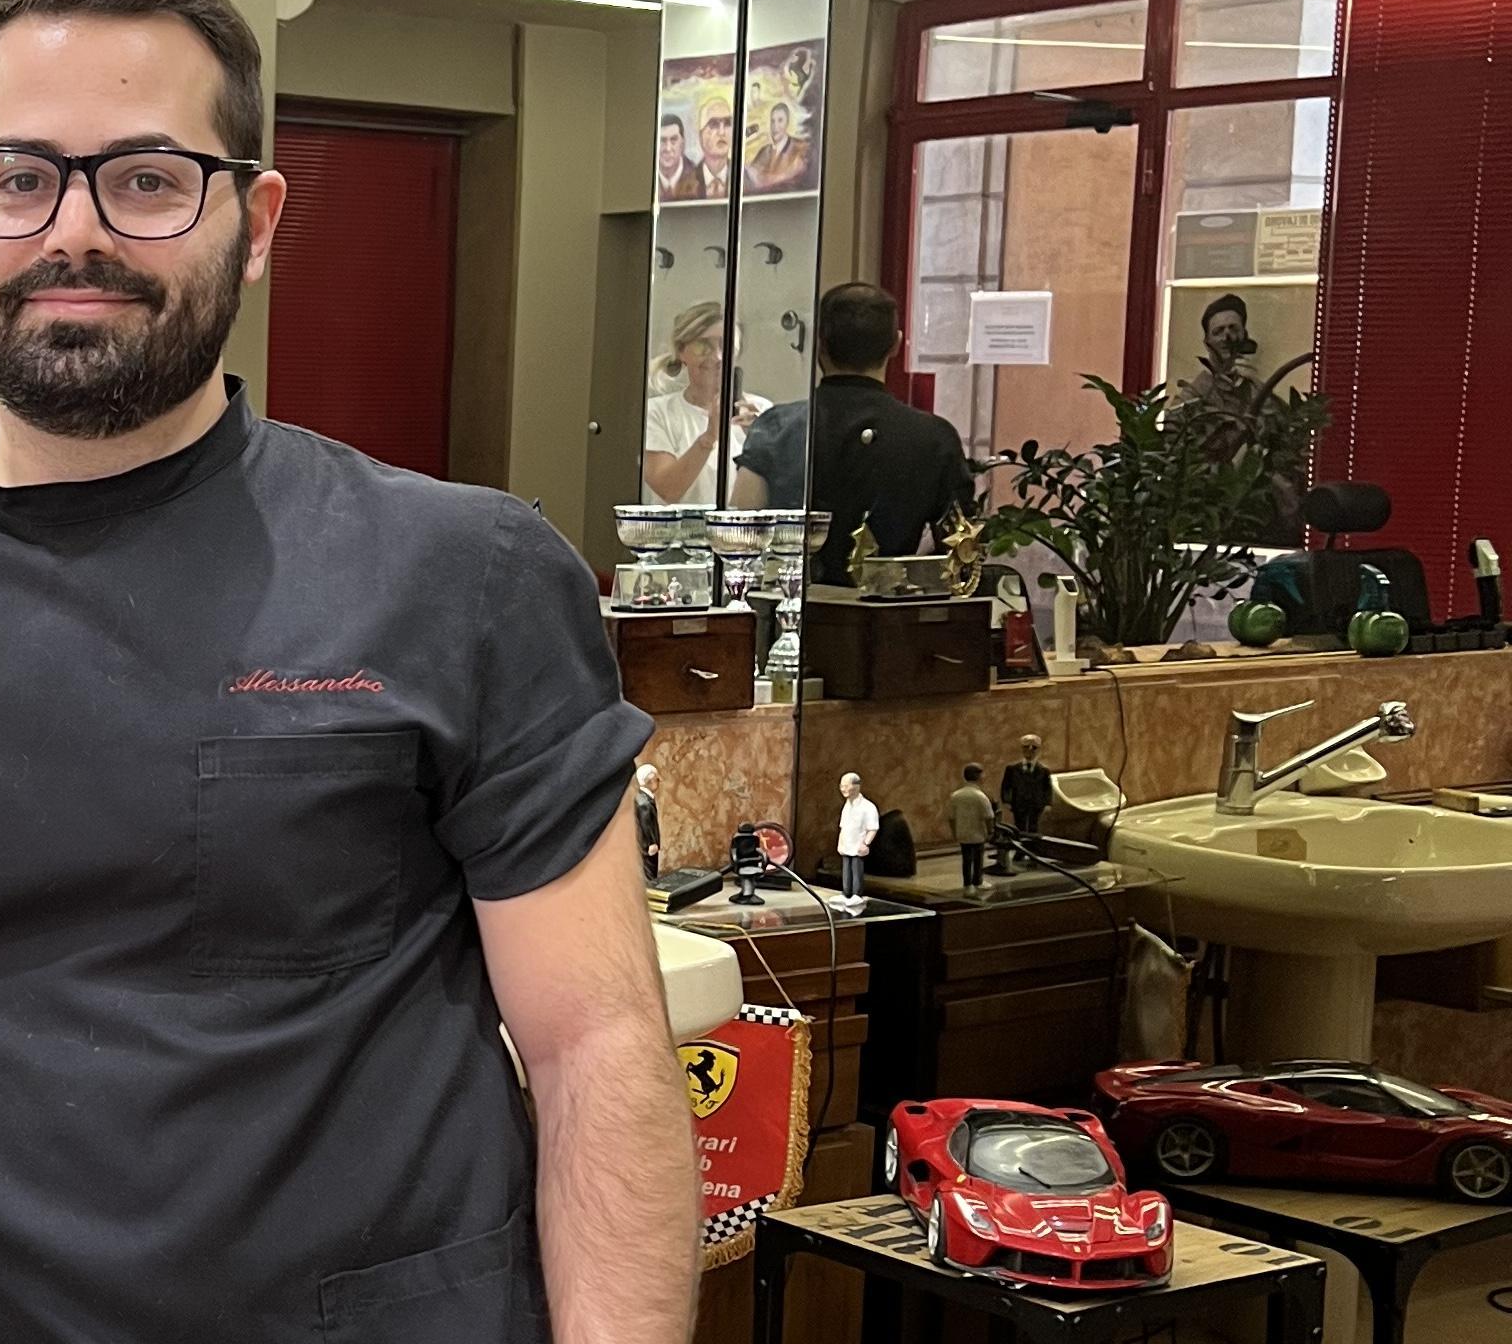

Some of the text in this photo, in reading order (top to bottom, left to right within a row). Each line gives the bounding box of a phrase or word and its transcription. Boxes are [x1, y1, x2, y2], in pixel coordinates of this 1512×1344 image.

[229, 668, 385, 693] Alessandro
[694, 1136, 738, 1153] rari
[701, 1181, 742, 1199] ena
